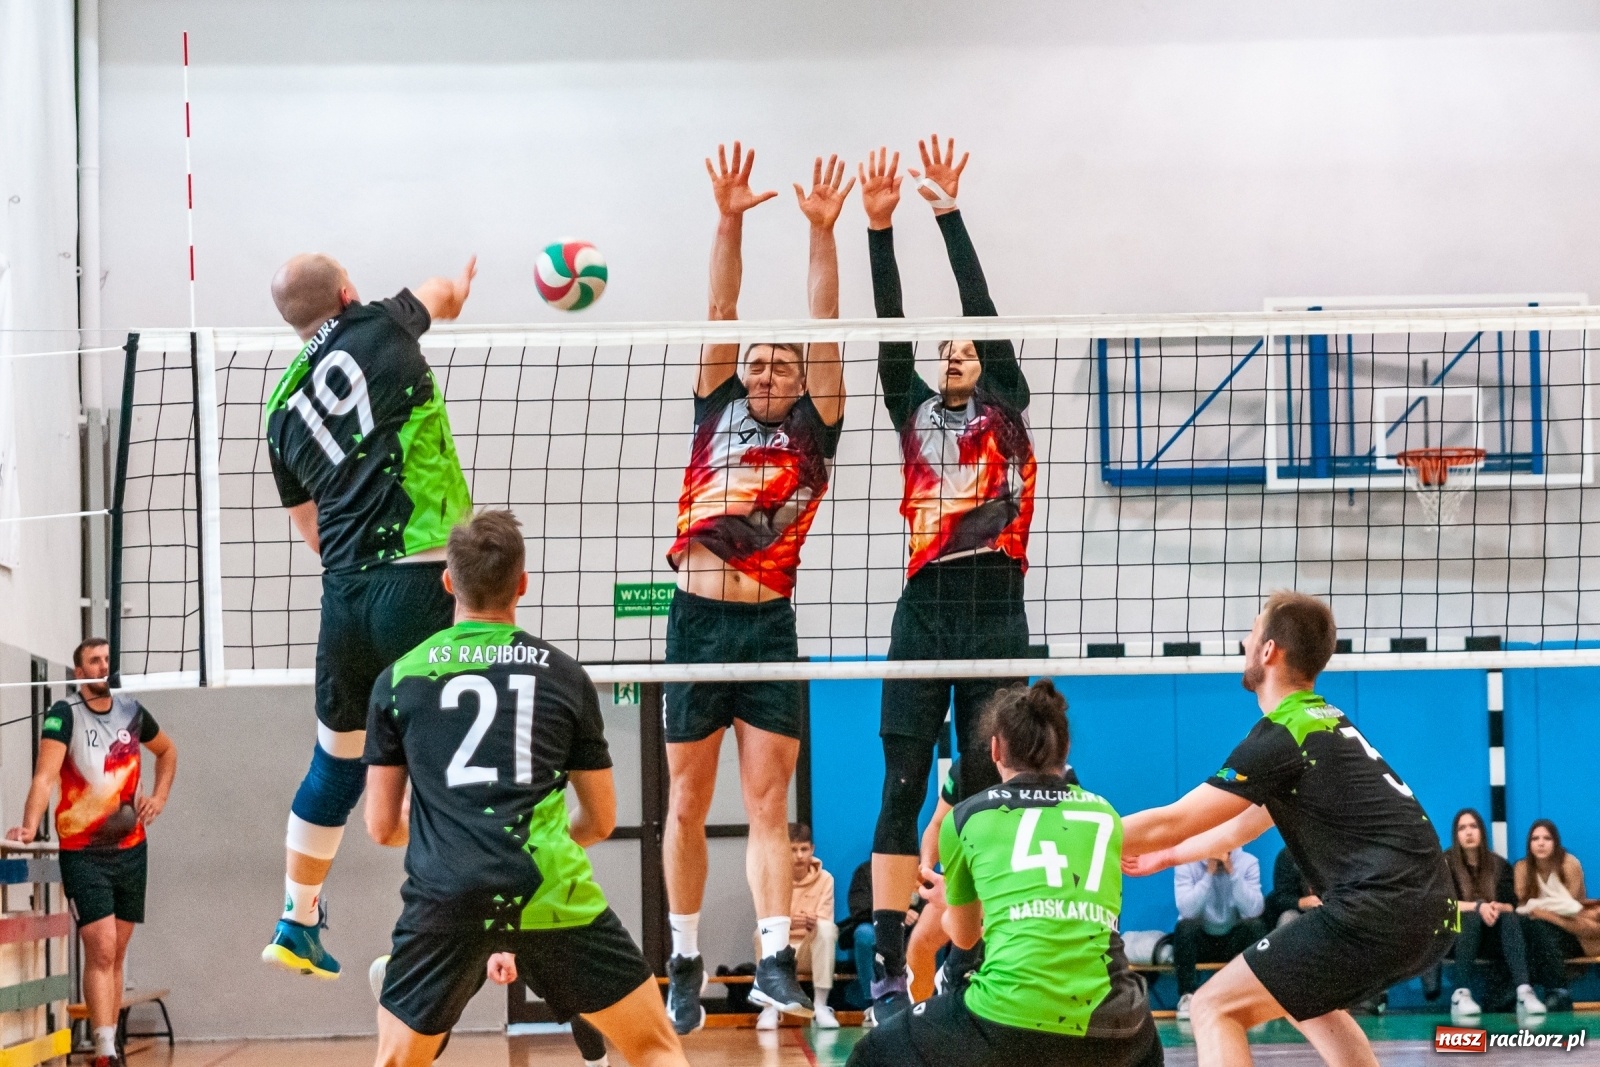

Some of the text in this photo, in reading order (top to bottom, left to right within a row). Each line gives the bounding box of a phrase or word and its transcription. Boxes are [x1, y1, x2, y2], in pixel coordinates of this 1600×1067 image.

[287, 349, 375, 466] 19
[428, 641, 550, 667] KS RACIBÓRZ
[85, 728, 99, 748] 12
[440, 674, 536, 788] 21
[1010, 808, 1115, 892] 47
